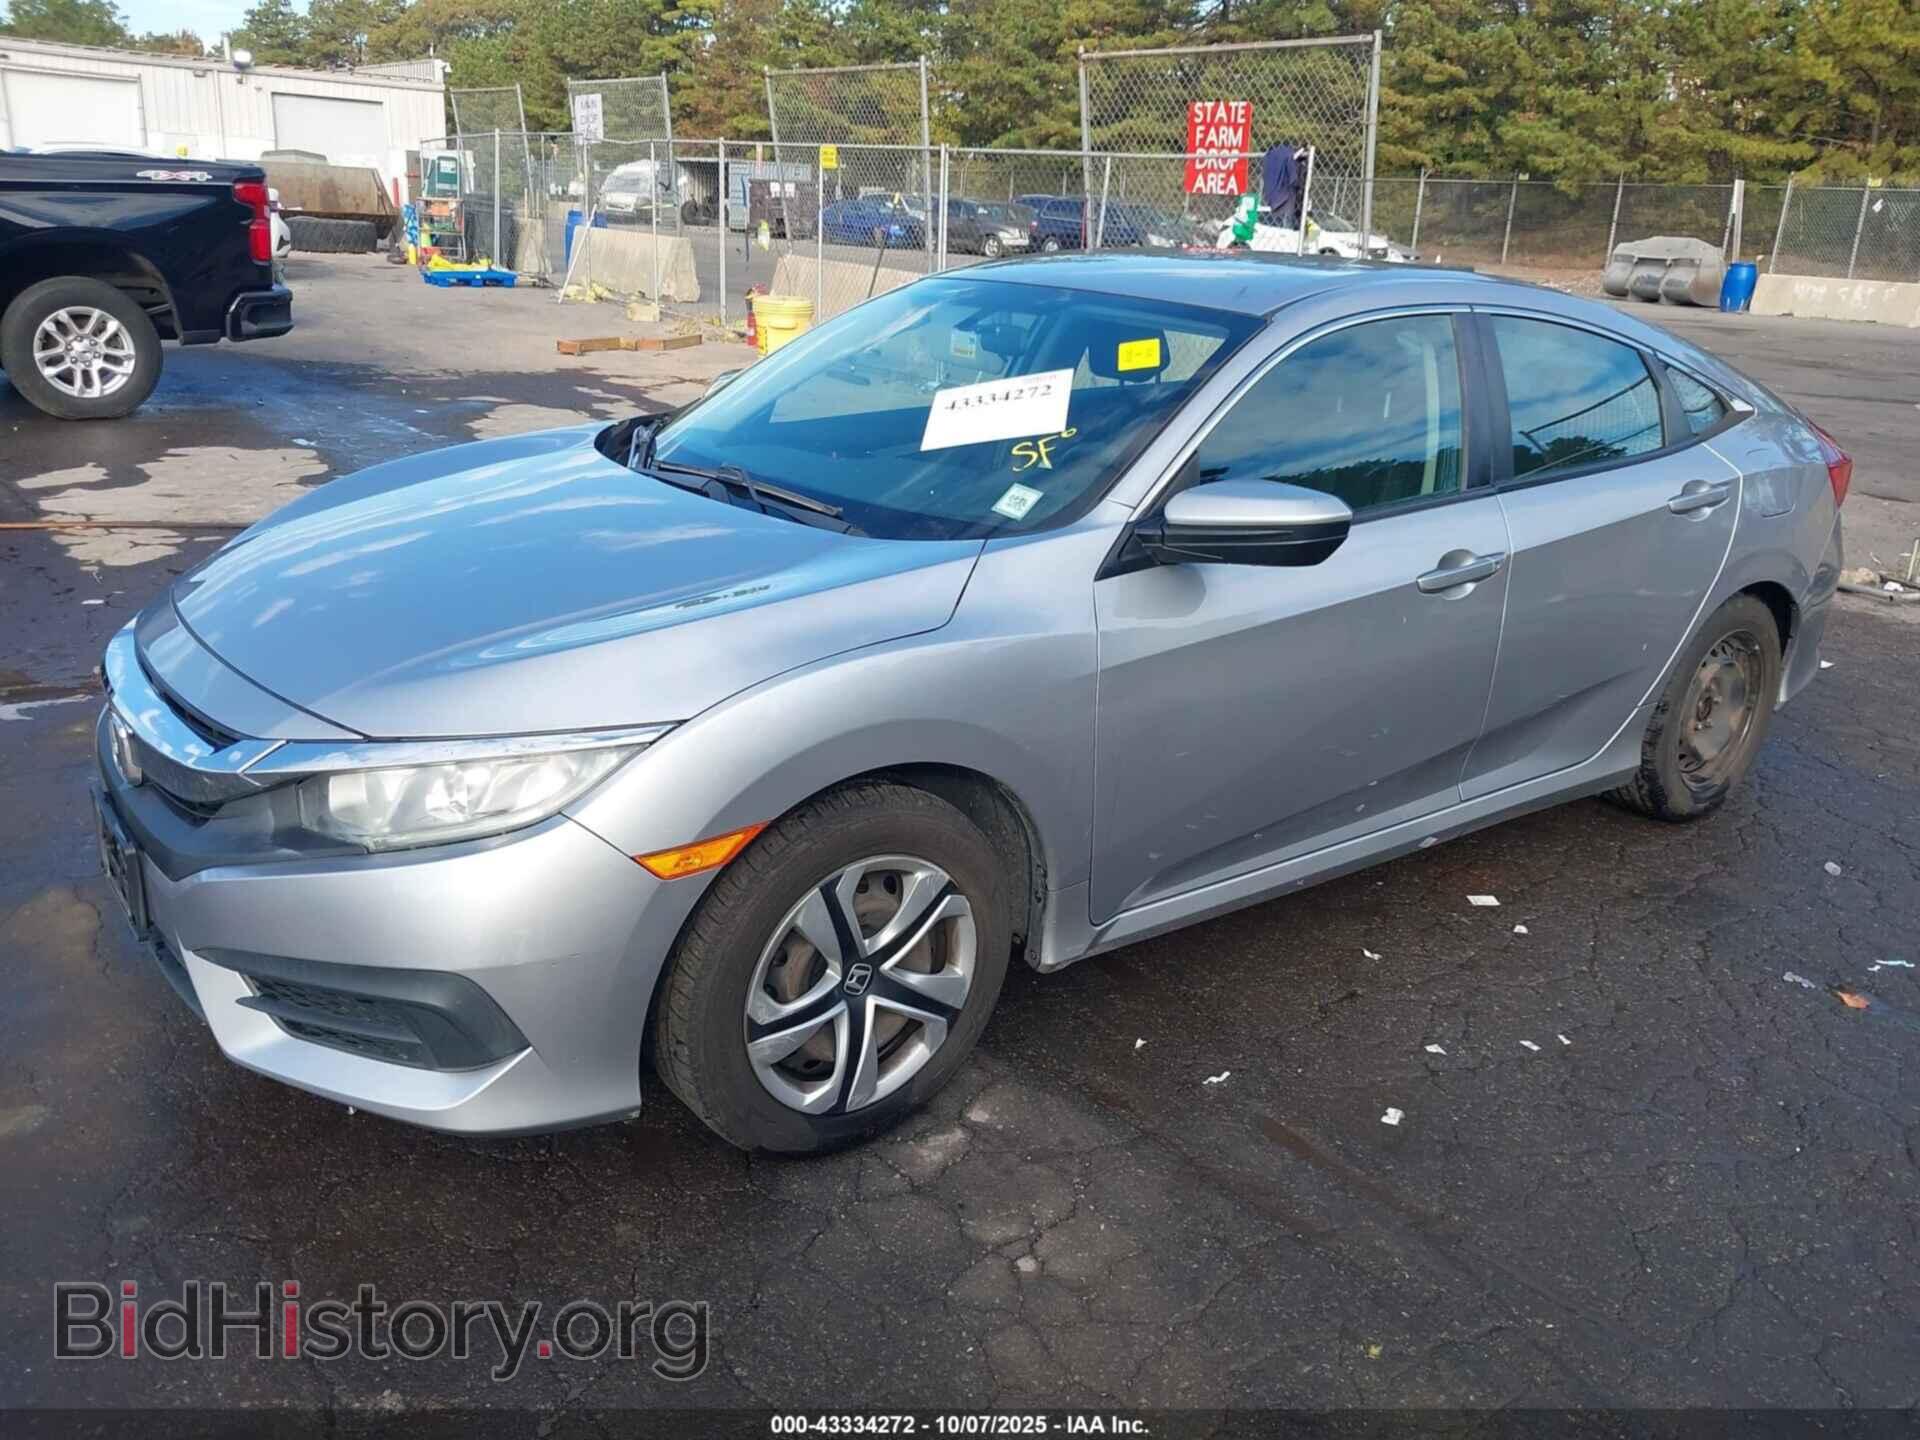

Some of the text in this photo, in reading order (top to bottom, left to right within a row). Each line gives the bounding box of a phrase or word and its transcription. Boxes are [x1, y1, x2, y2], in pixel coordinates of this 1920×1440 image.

[1194, 101, 1247, 123] STATE
[1196, 126, 1243, 147] FARM
[1195, 147, 1240, 171] DROP
[1192, 173, 1239, 195] AREA
[944, 384, 1052, 410] 43334272
